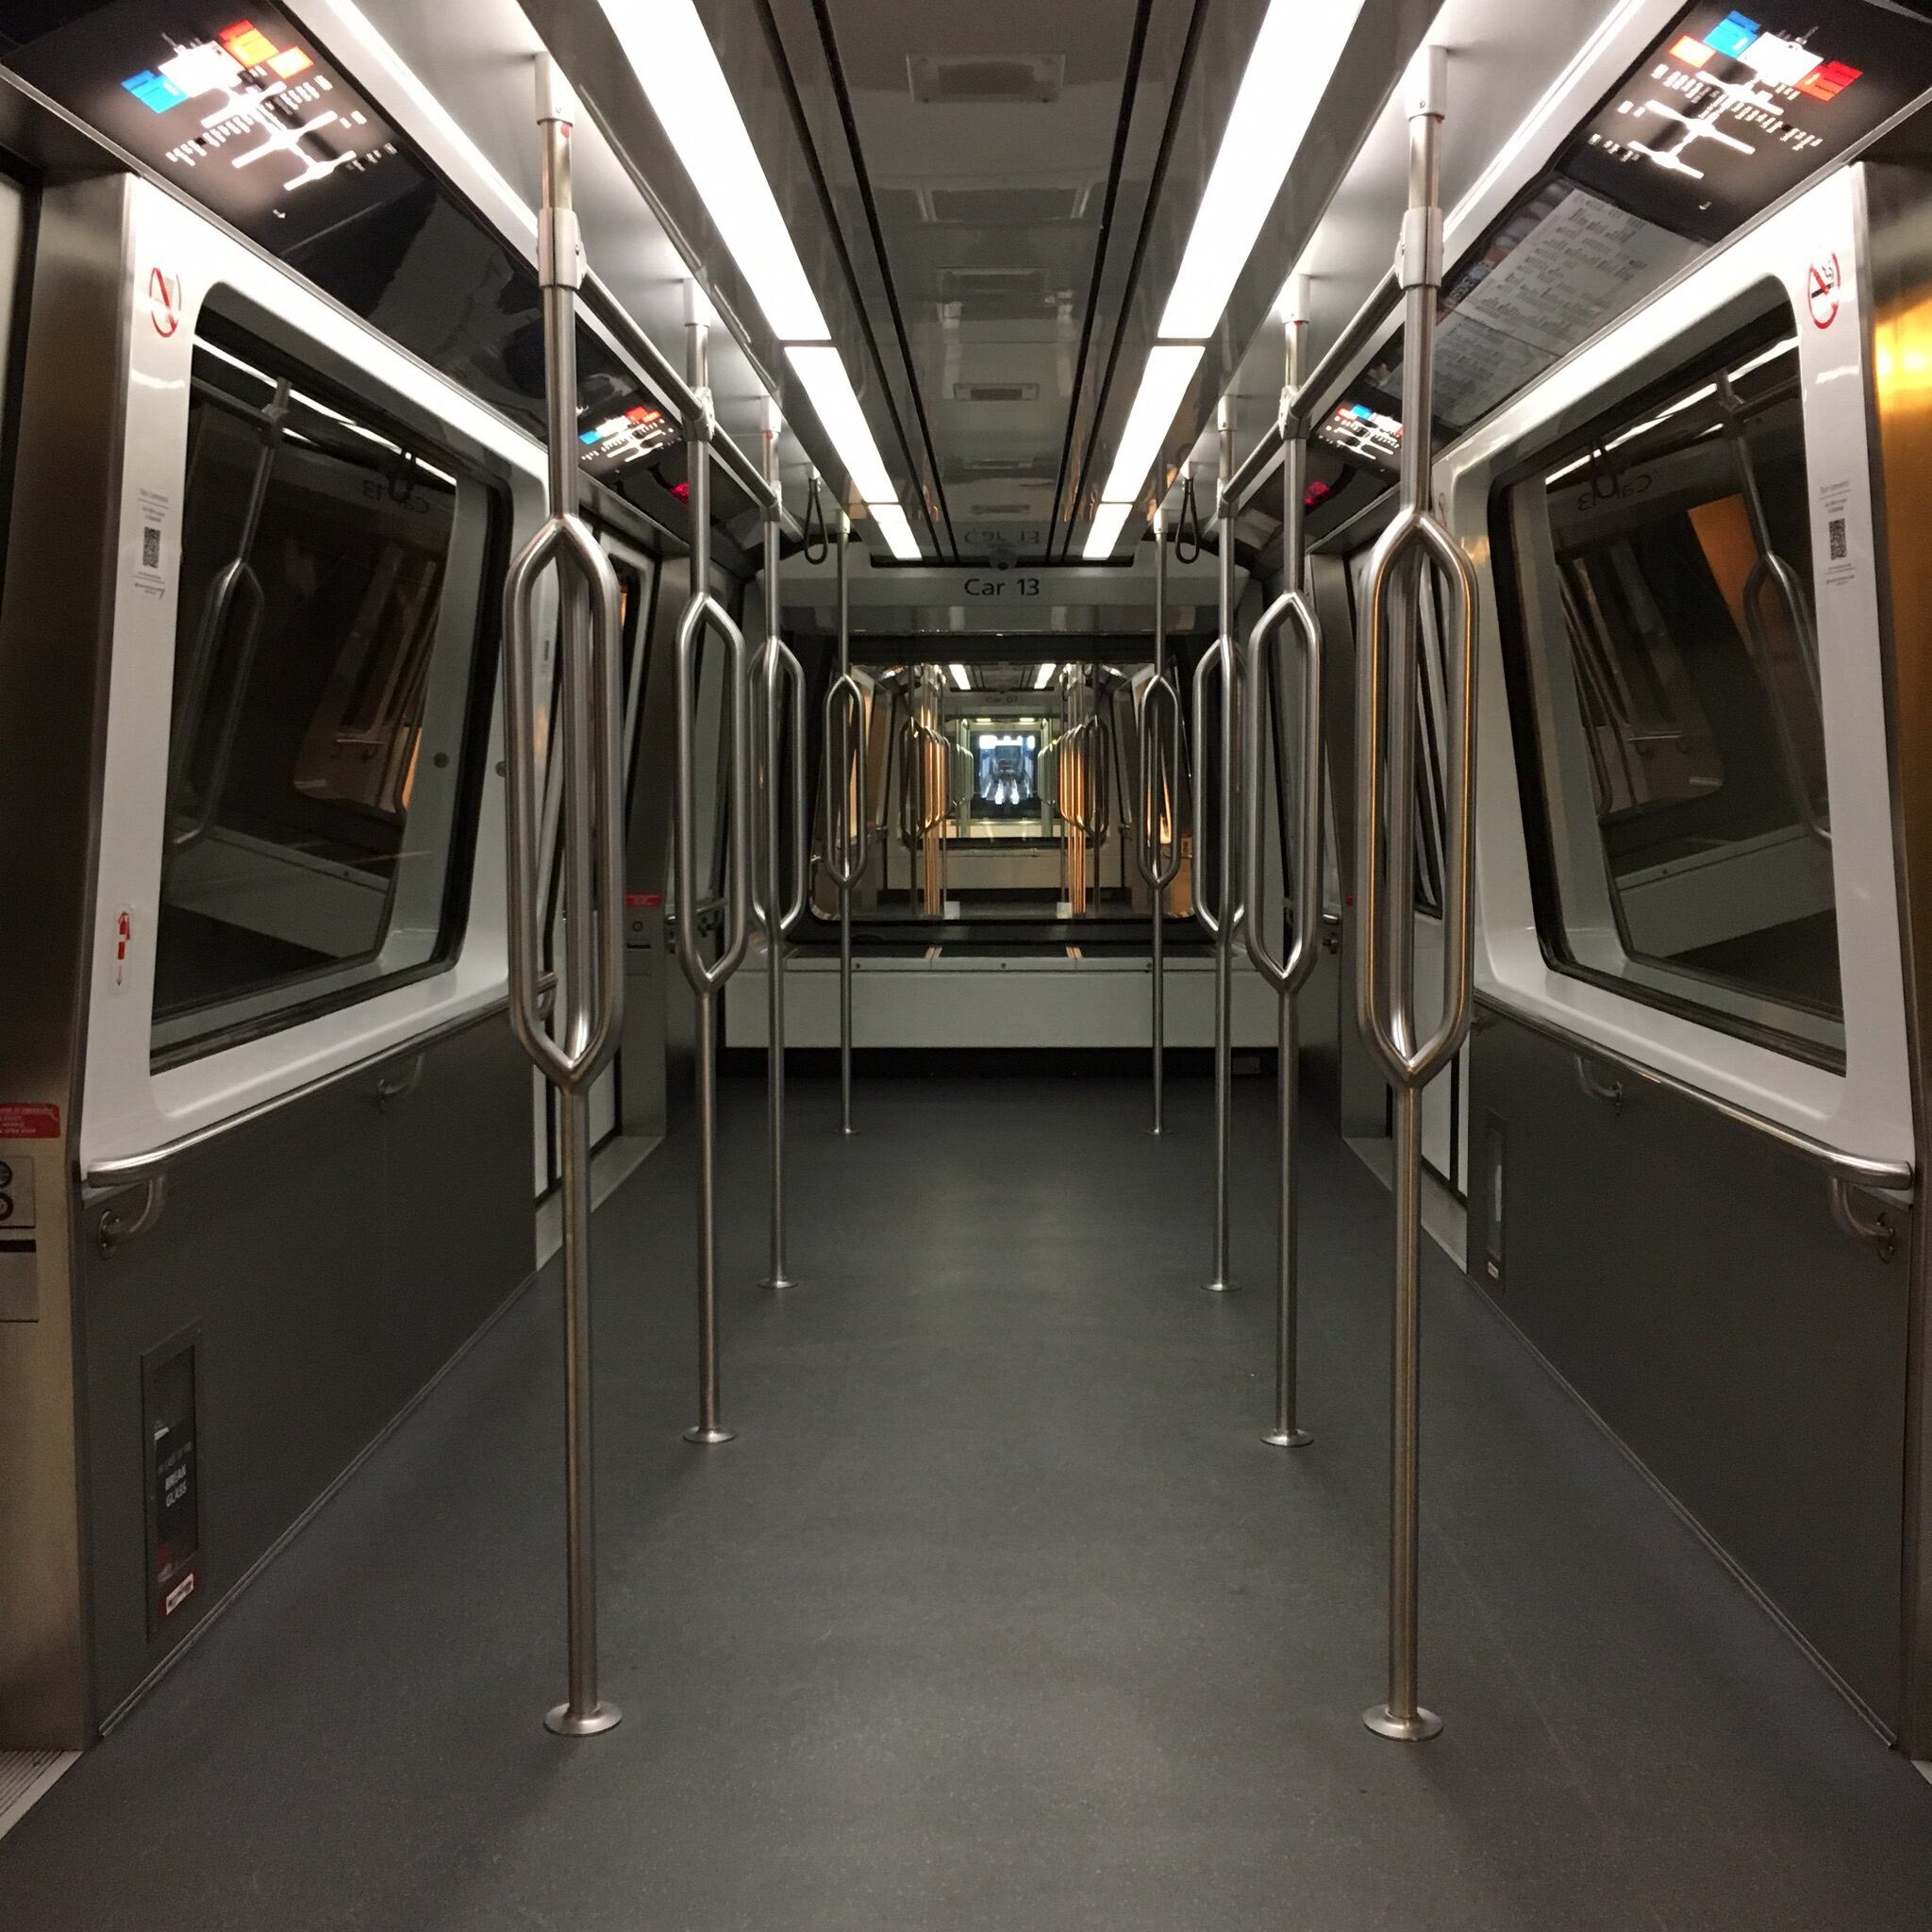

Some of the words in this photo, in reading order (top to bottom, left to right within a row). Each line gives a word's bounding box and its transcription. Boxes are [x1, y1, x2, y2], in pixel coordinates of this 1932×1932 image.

[964, 578, 1005, 596] Car
[1017, 578, 1041, 596] 13
[985, 695, 1003, 704] Car
[165, 1480, 188, 1507] GLASS
